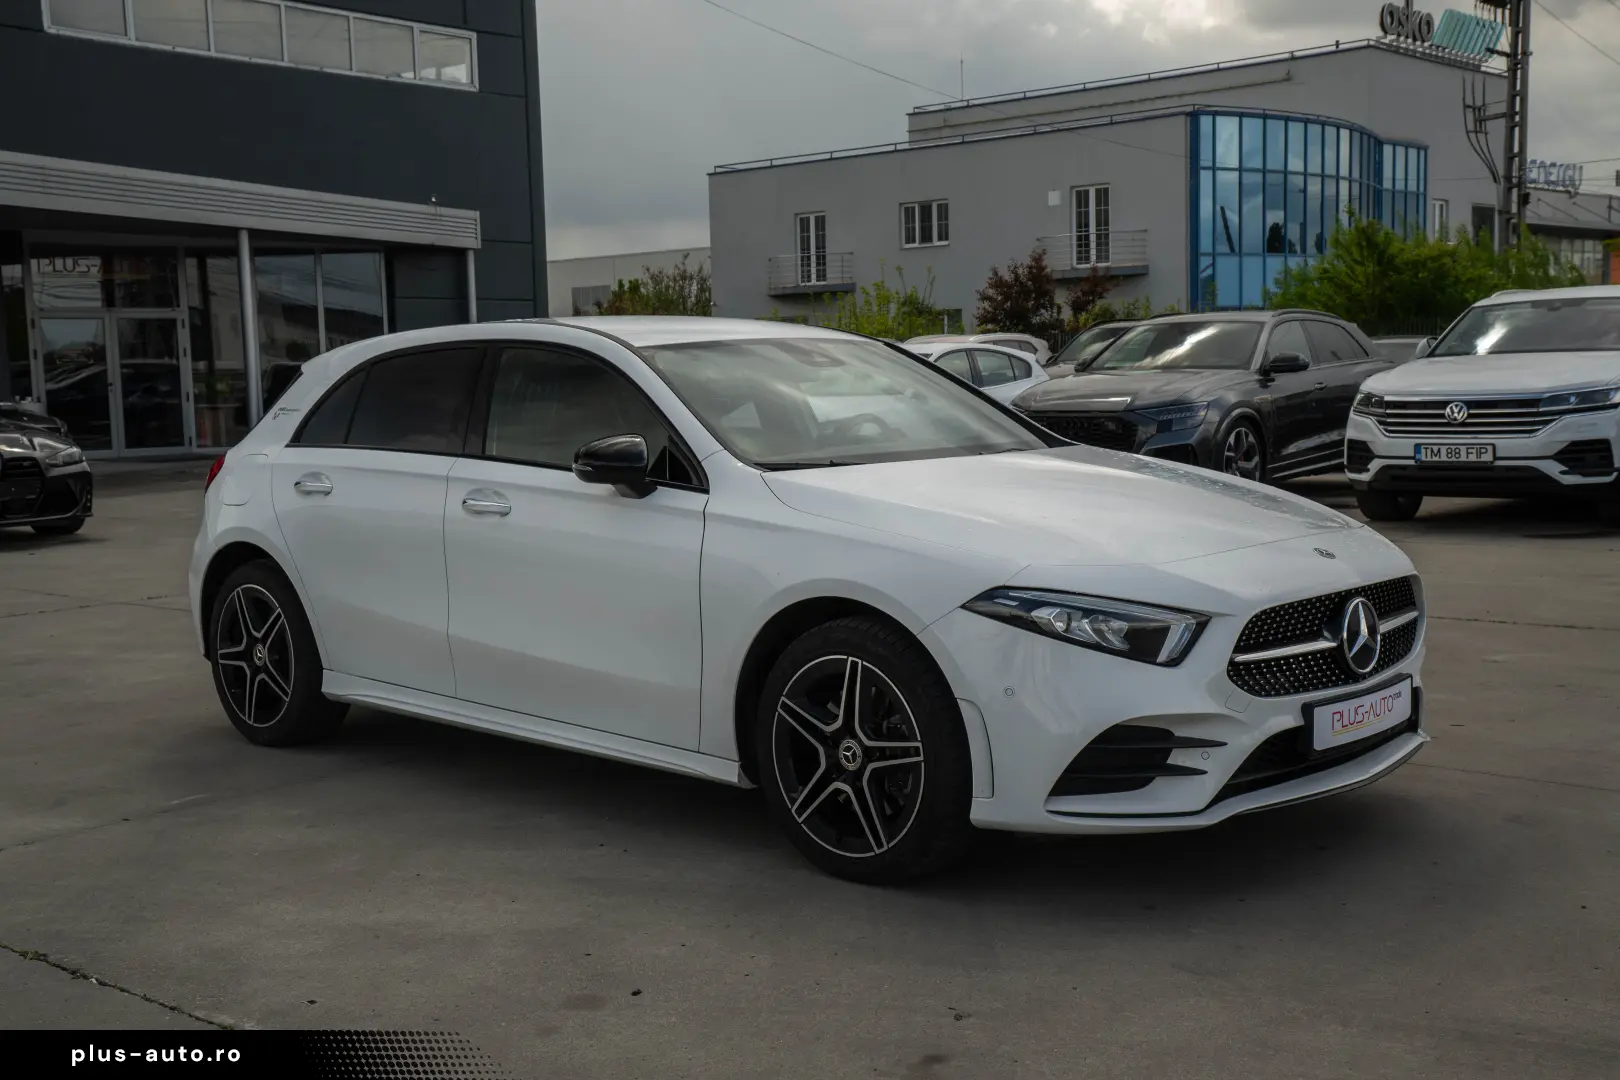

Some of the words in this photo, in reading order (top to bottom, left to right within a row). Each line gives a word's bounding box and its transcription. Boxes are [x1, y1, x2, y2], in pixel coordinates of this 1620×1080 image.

[1423, 447, 1441, 459] TM
[1446, 447, 1461, 459] 88
[1466, 447, 1488, 459] FIP
[1331, 696, 1394, 730] PLUS-AUTO
